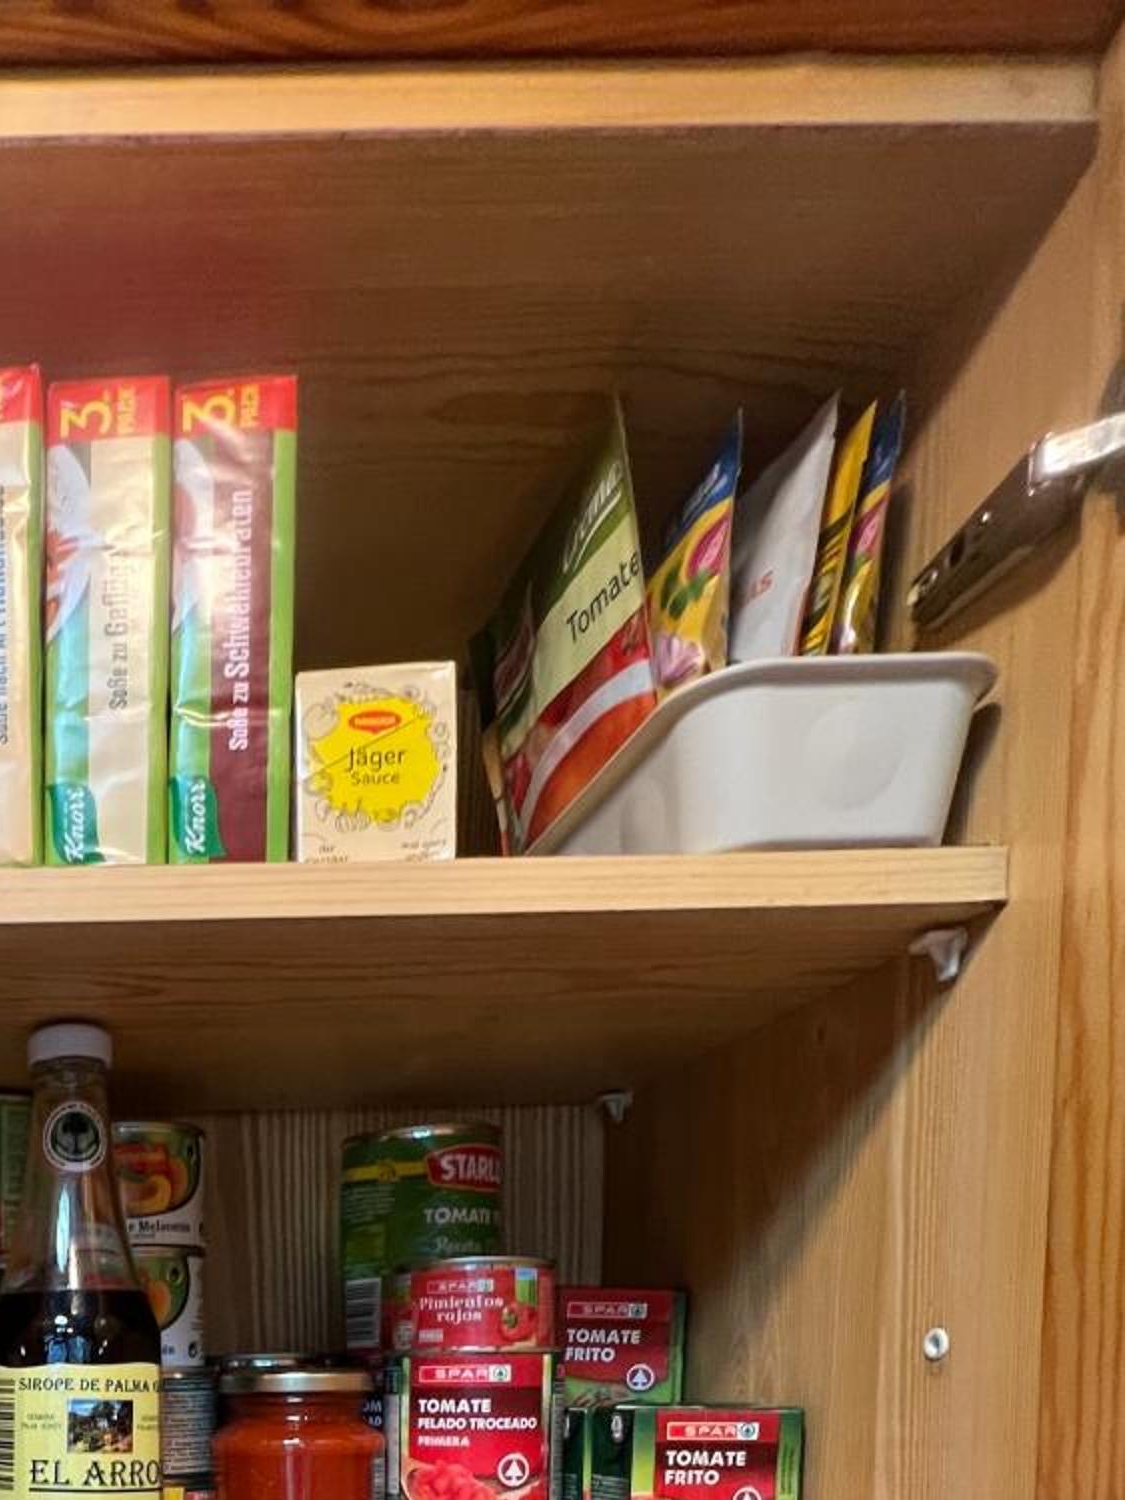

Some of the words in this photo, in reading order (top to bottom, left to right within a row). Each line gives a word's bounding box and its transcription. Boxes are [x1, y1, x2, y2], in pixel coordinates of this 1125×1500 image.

[232, 681, 250, 704] zu
[349, 746, 406, 772] Jäger
[350, 772, 401, 786] Sauce
[184, 780, 206, 855] Knorr
[435, 1308, 483, 1325] rojos
[566, 1328, 642, 1345] TOMATE
[564, 1346, 616, 1363] FRITO
[18, 1377, 75, 1392] SIROPE
[79, 1377, 101, 1392] DE
[104, 1379, 150, 1393] PALMA
[417, 1398, 492, 1414] TOMATE
[417, 1417, 468, 1430] PELADO
[469, 1416, 538, 1430] TROCEADO
[684, 1425, 738, 1438] SPAR
[665, 1450, 747, 1467] TOMATE
[29, 1459, 71, 1486] EL
[82, 1459, 161, 1487] ARRO
[663, 1469, 720, 1486] FRITO
